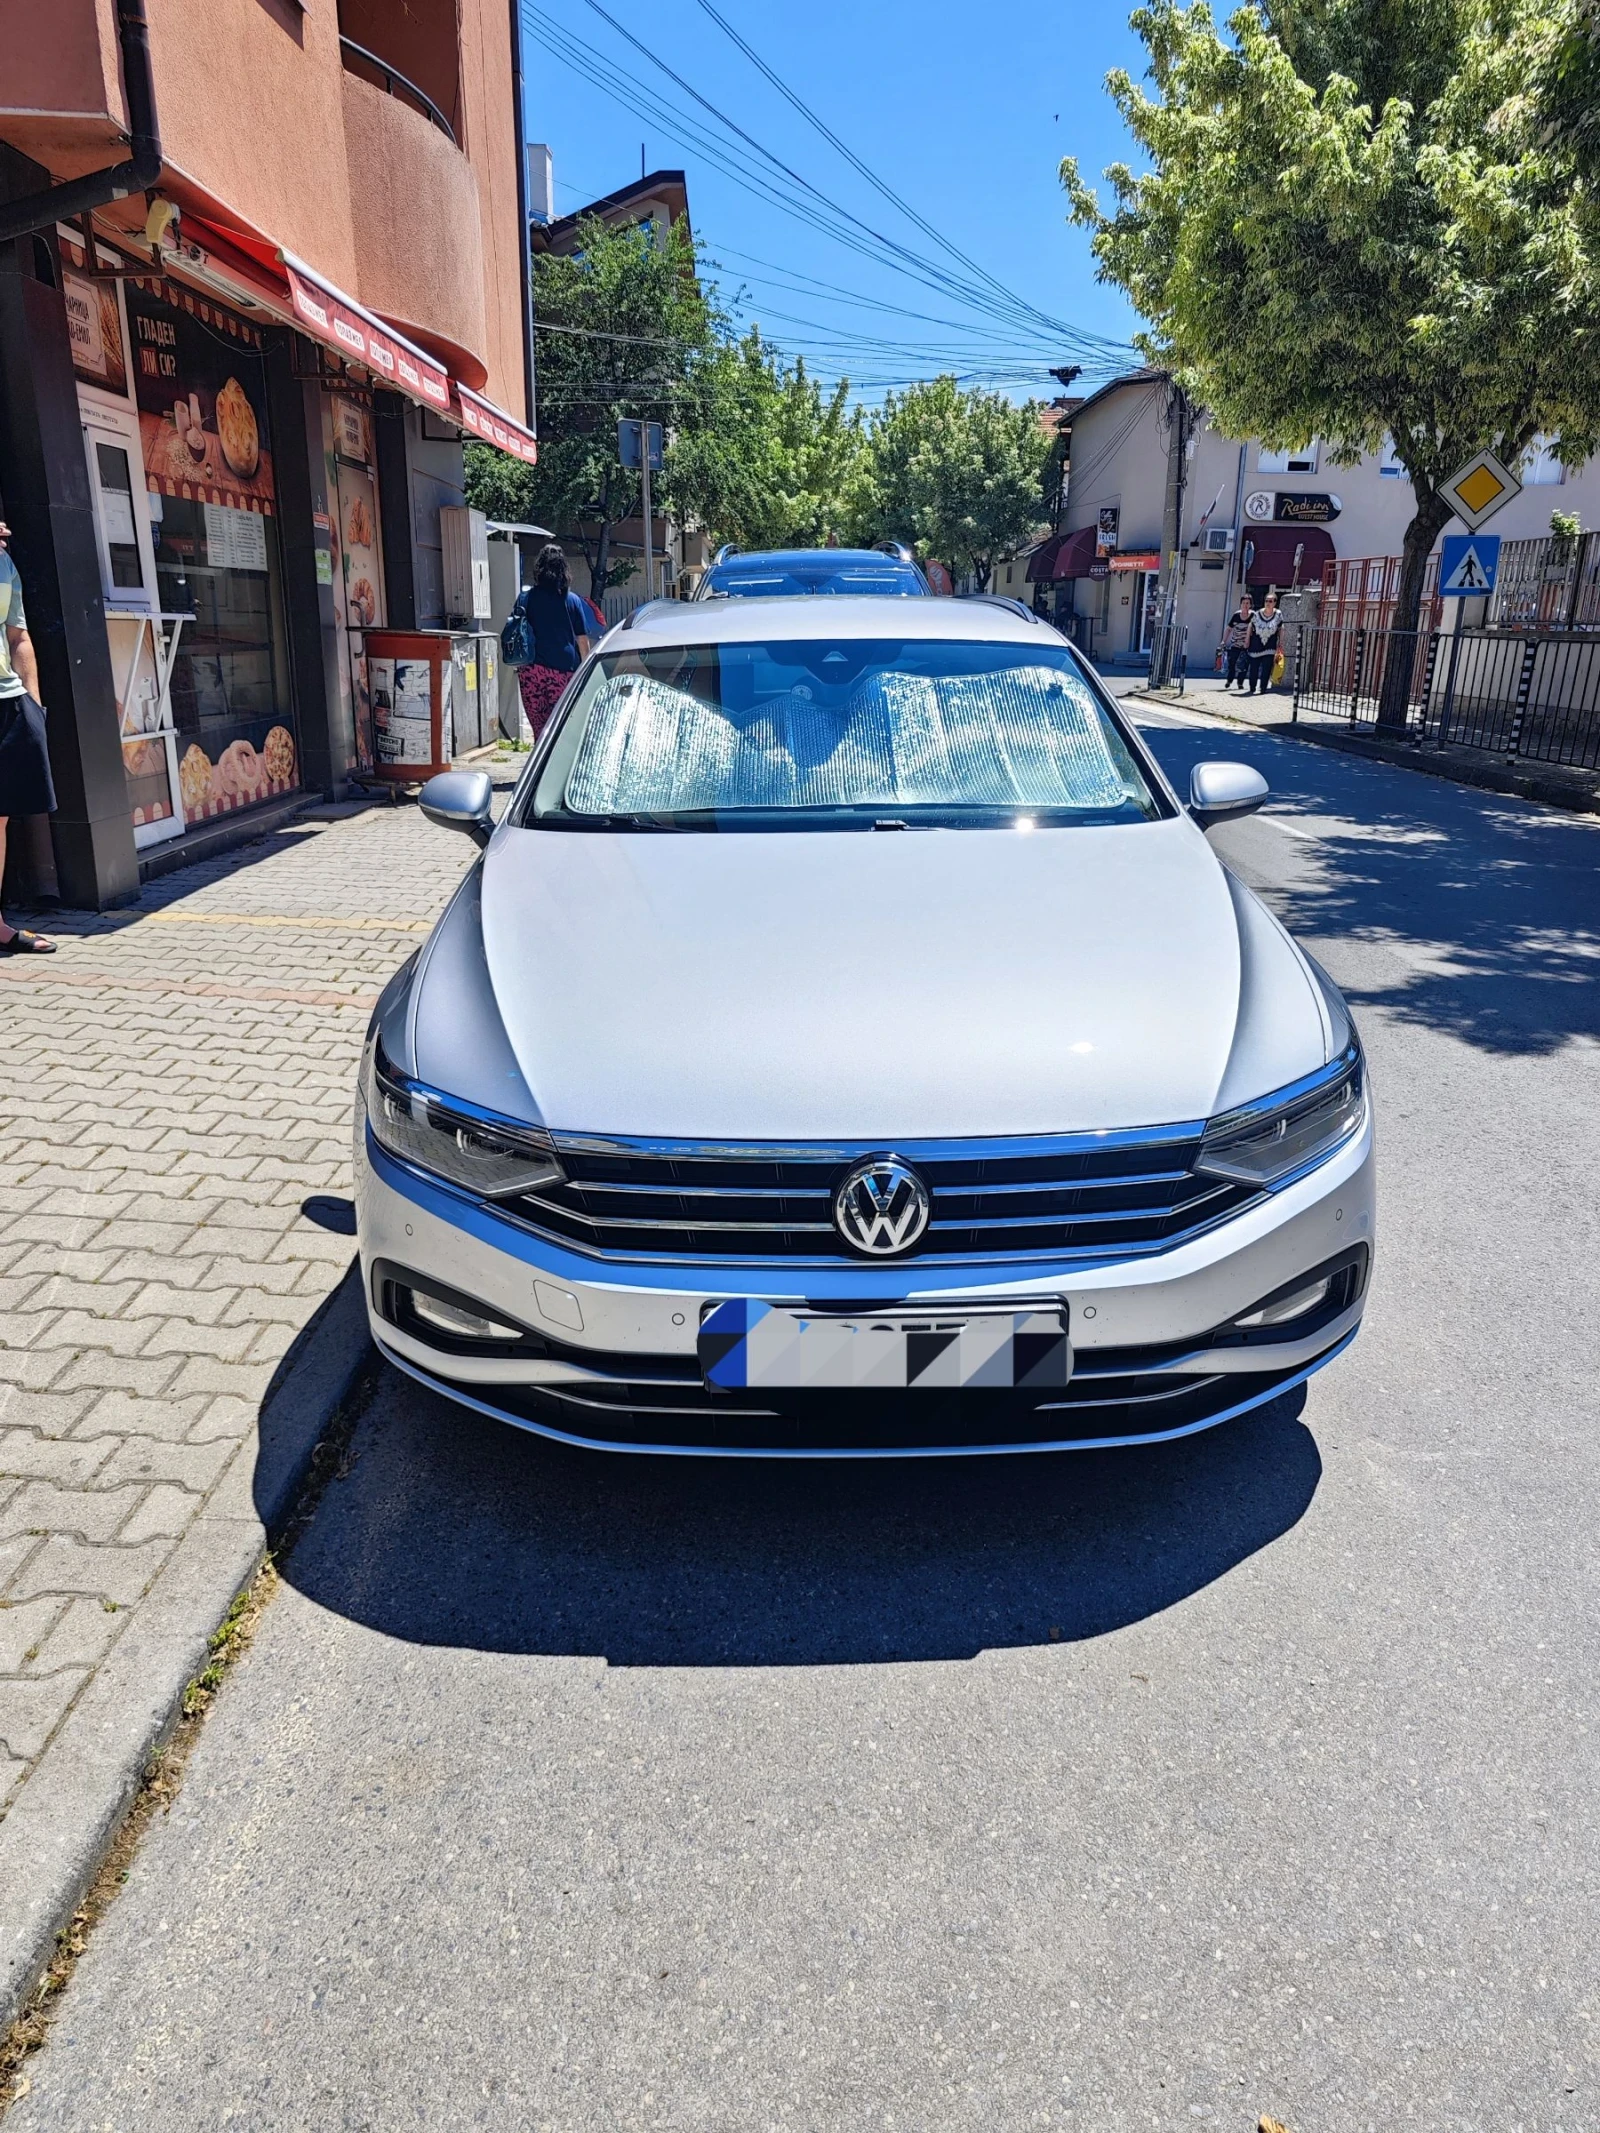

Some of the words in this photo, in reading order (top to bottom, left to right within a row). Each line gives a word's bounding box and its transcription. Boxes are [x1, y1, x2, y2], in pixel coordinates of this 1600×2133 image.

[136, 315, 176, 347] ГЛАДЕН
[142, 350, 158, 374] ЛИ
[158, 353, 176, 377] СИ?
[1281, 497, 1312, 517] Radi
